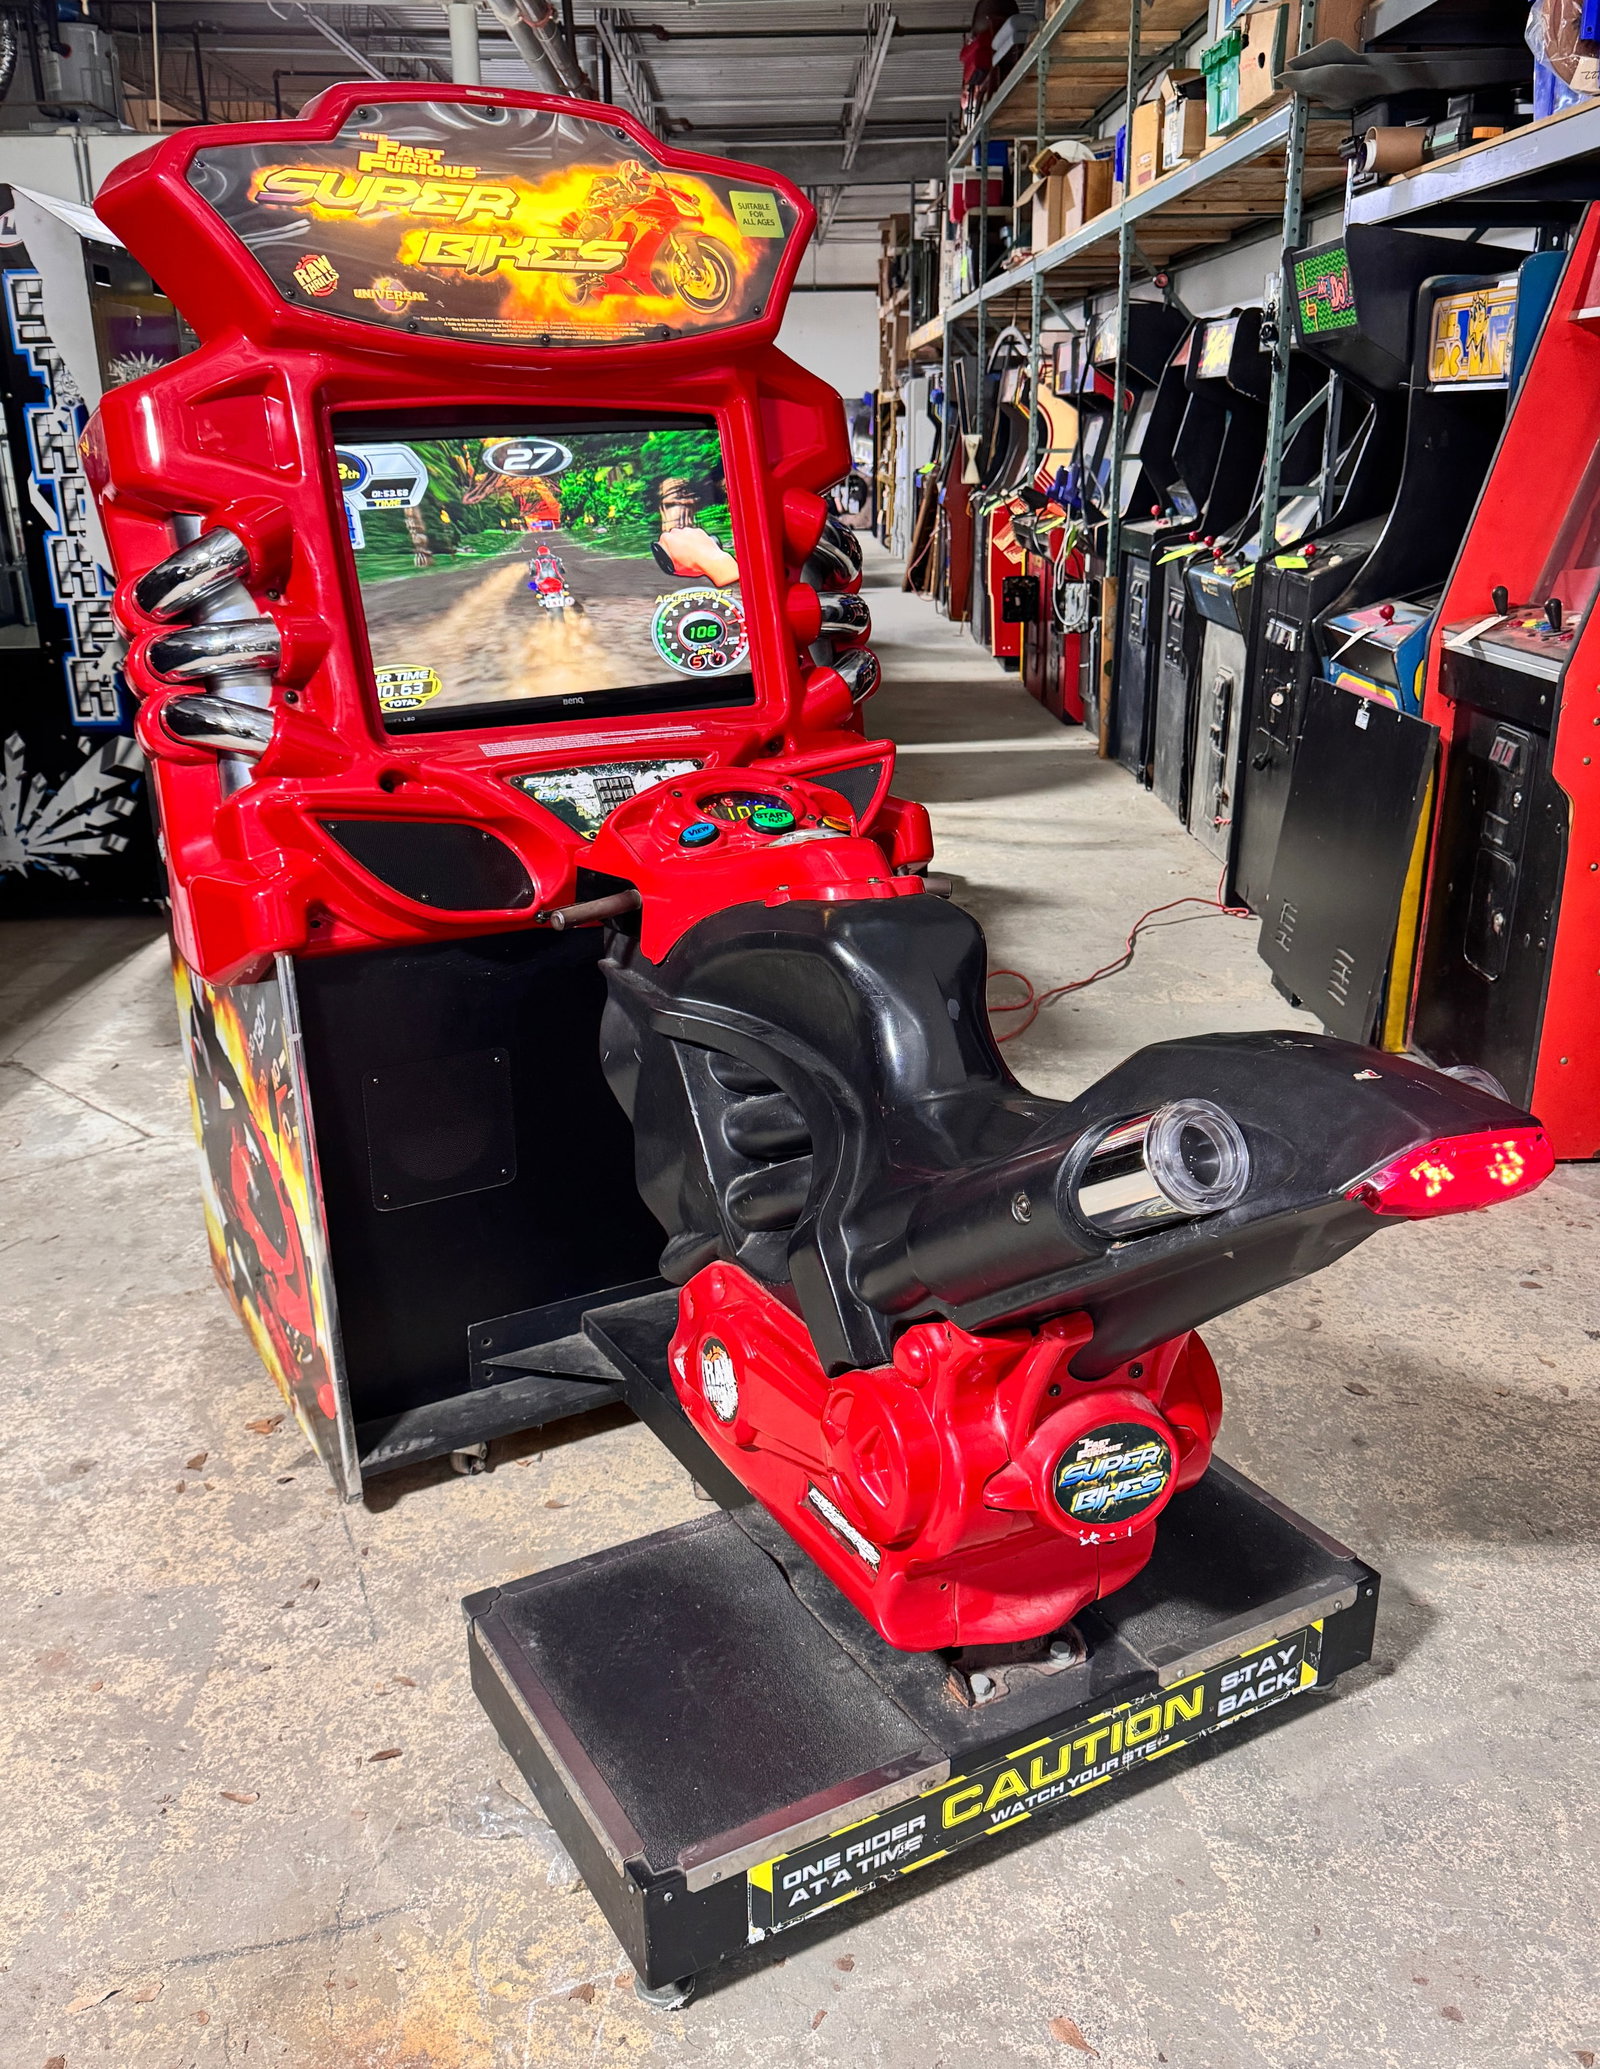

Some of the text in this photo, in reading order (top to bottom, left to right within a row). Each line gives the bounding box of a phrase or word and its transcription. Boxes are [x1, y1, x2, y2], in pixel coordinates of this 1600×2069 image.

[377, 140, 445, 161] FAST
[358, 151, 480, 179] FURIOUS
[255, 168, 519, 224] SUPER
[737, 202, 771, 211] SUITABLE
[742, 218, 775, 226] ALL AGES
[749, 210, 764, 218] FOR
[418, 231, 629, 276] BIKES
[293, 255, 333, 287] RAW
[303, 269, 339, 295] THRILLS
[353, 288, 429, 302] UNIVERSAL
[503, 447, 557, 471] 27
[655, 588, 733, 604] ACCELERATE
[689, 624, 718, 640] 106
[692, 656, 703, 668] 5
[395, 670, 429, 681] TIME
[388, 698, 419, 708] TOTAL
[755, 811, 789, 820] START
[687, 824, 710, 837] VIEW
[1060, 1445, 1161, 1488] SUPER
[1074, 1470, 1164, 1513] BIKES
[1220, 1645, 1297, 1693] STAY
[1217, 1667, 1297, 1717] BACK
[941, 1684, 1205, 1829] CAUTION
[990, 1734, 1170, 1824] WATCH YOUR STEP
[782, 1814, 927, 1891] ONE RIDER
[788, 1834, 925, 1907] AT A TIME
